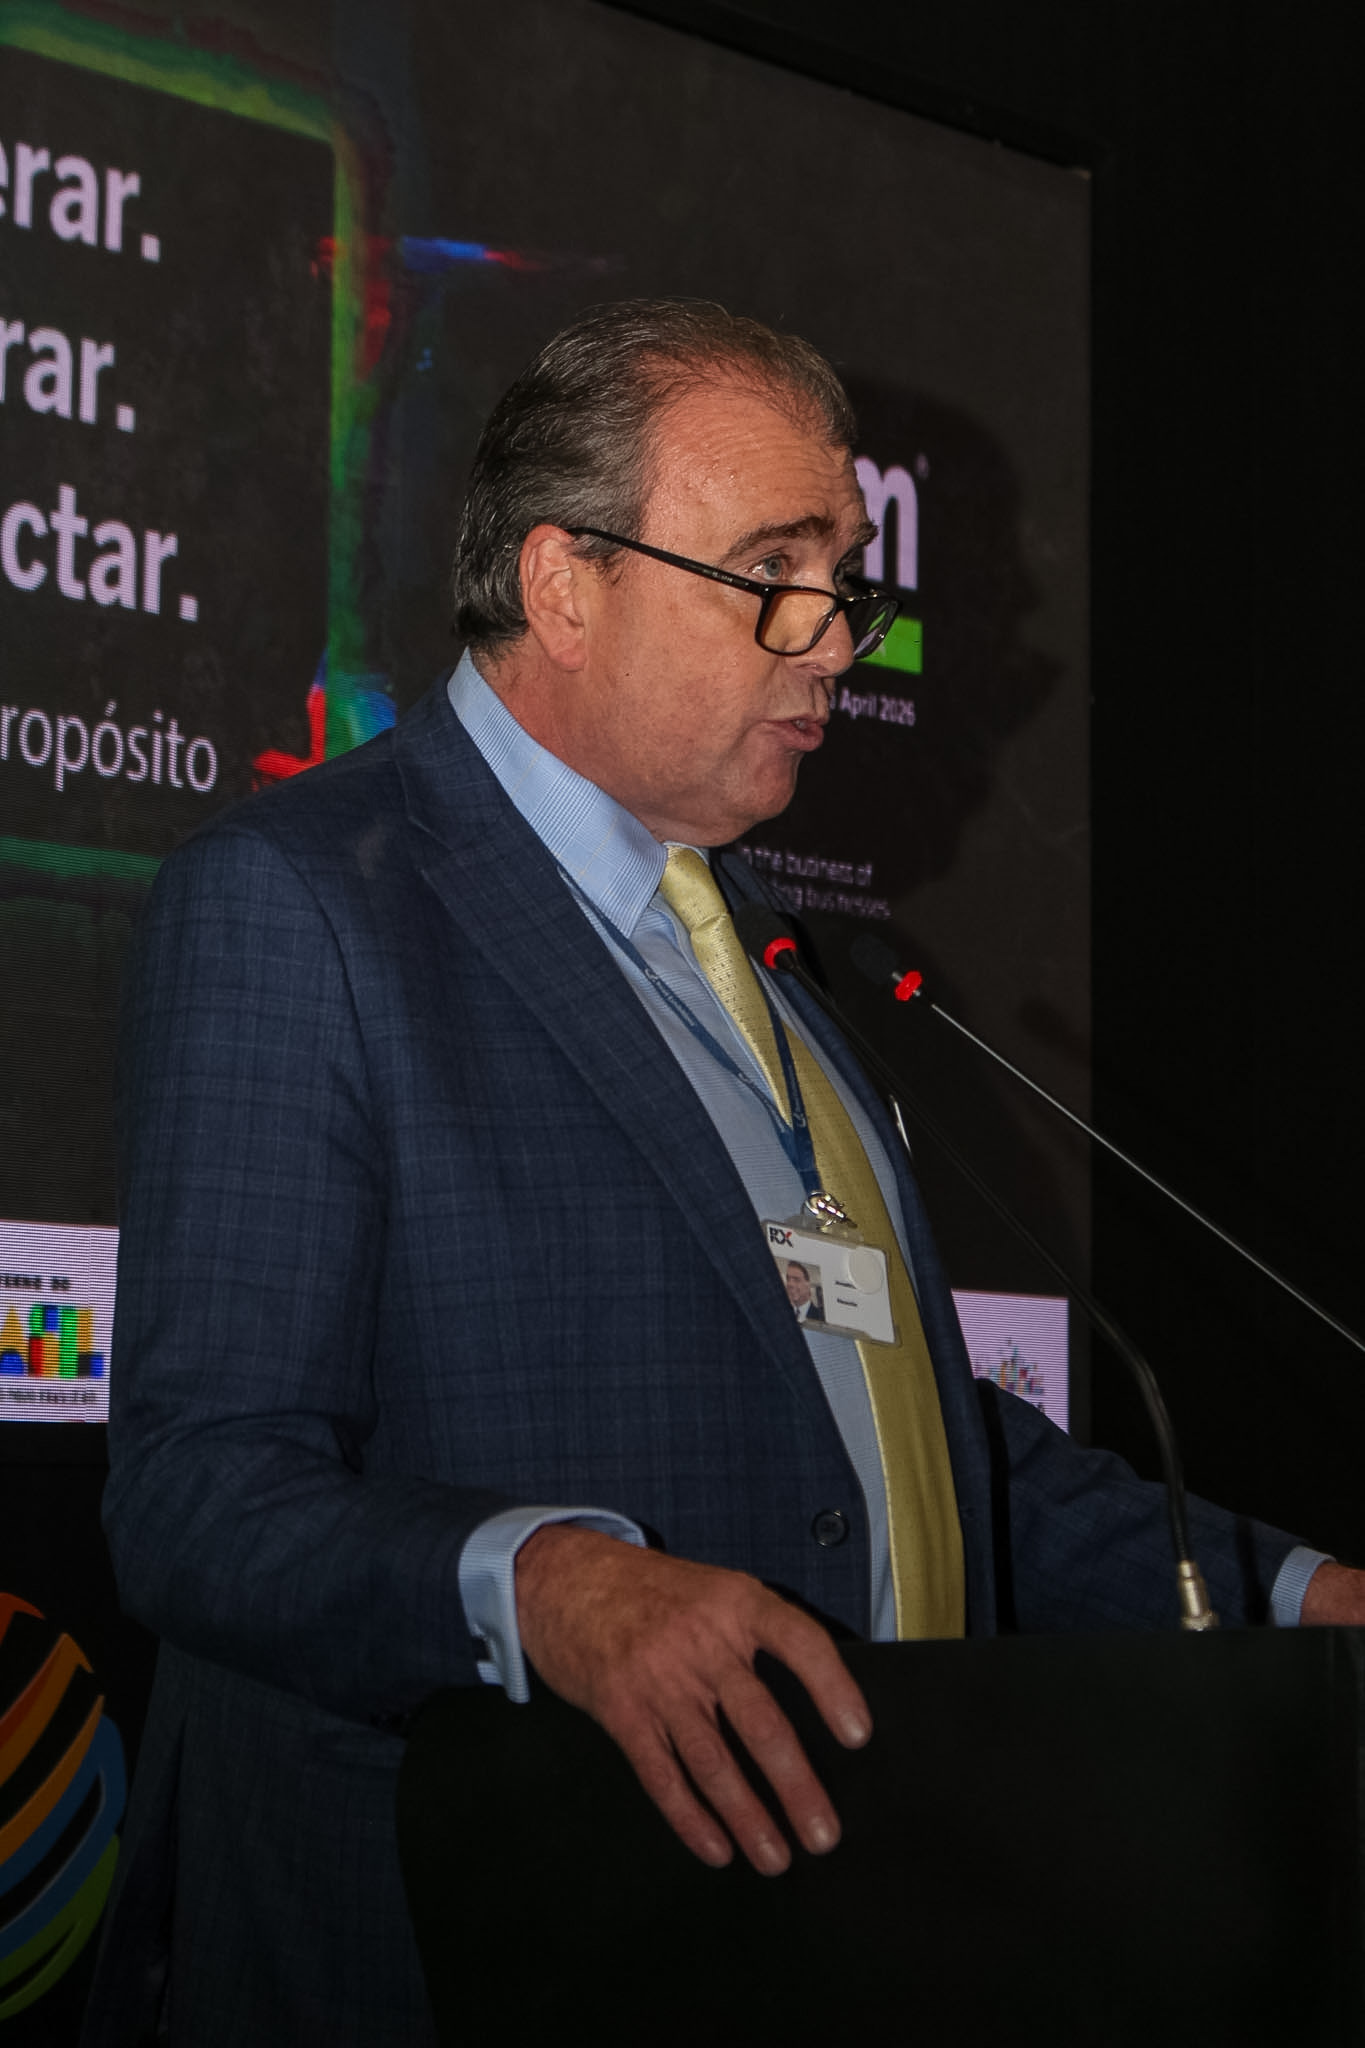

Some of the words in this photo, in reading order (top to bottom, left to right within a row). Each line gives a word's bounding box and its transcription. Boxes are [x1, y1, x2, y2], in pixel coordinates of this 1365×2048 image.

[0, 141, 160, 263] rar.
[0, 482, 199, 623] ctar.
[839, 686, 877, 720] April
